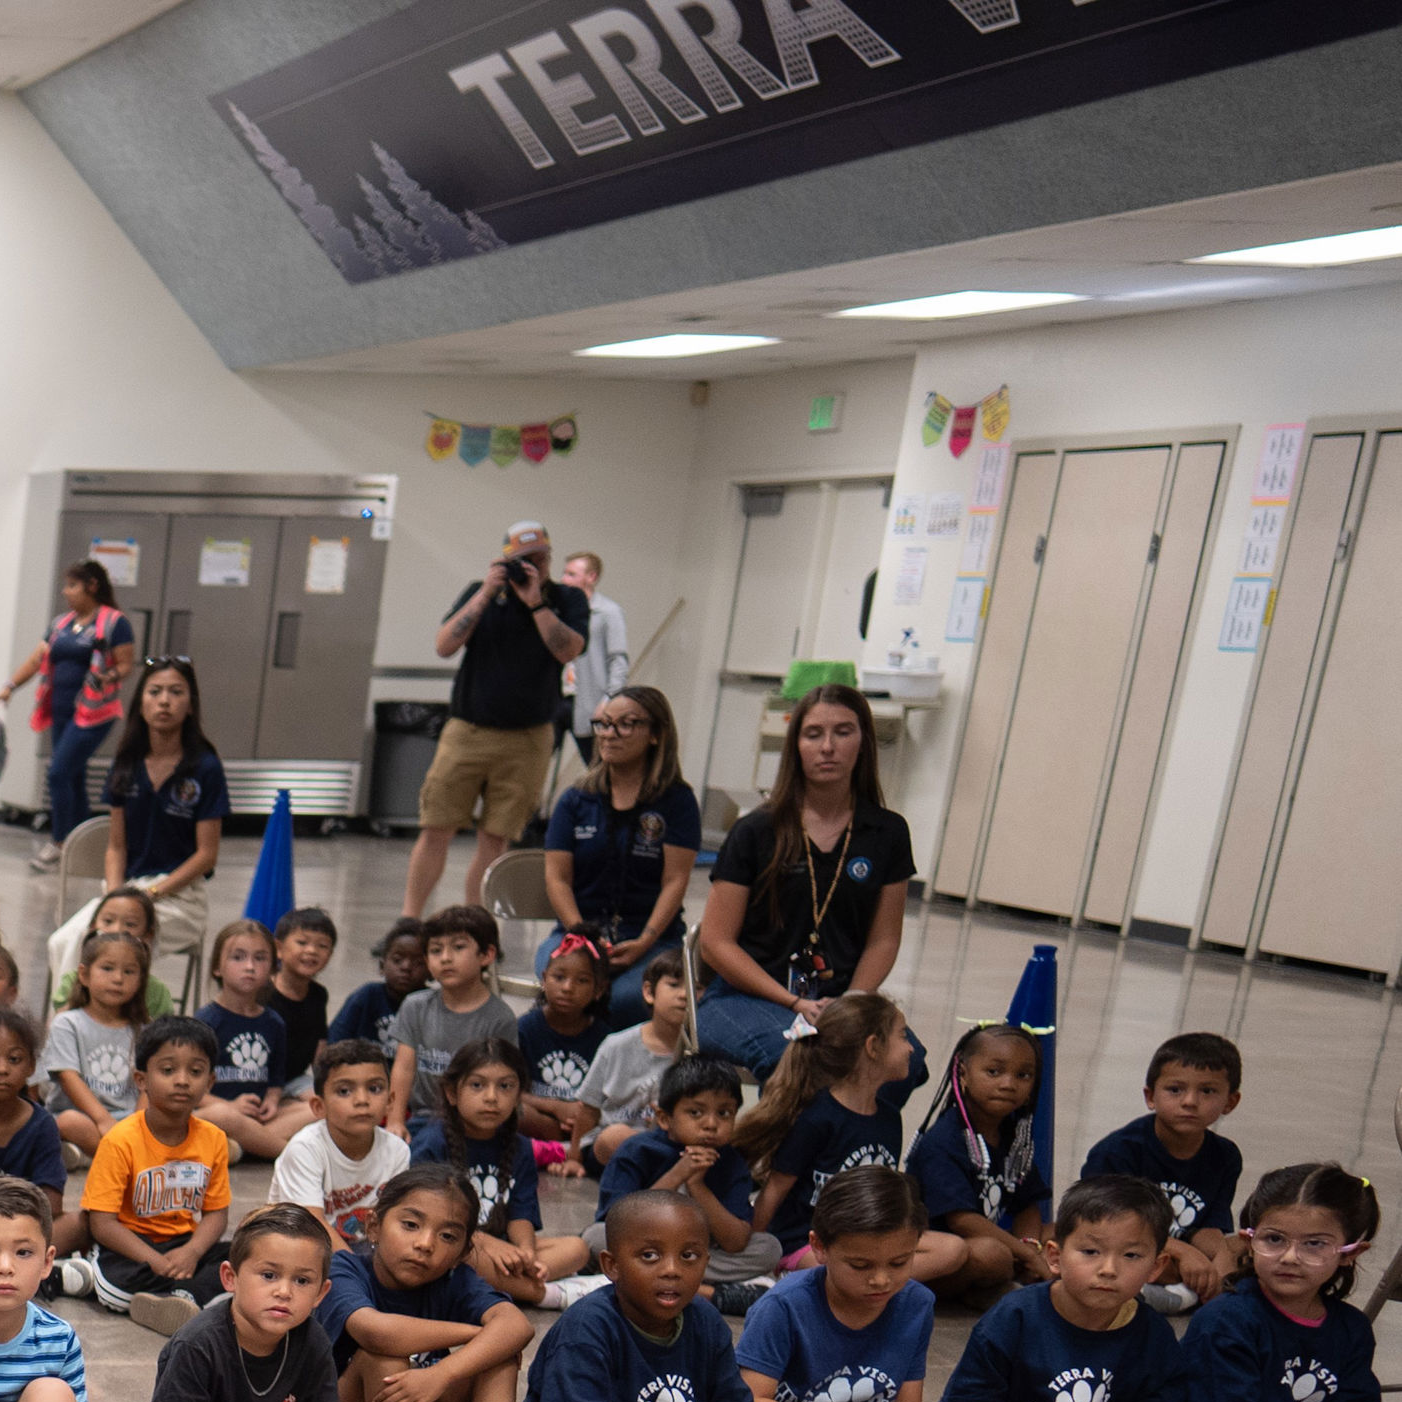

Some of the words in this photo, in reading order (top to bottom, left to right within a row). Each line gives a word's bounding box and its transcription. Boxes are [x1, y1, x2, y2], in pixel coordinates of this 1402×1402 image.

[448, 0, 902, 170] TERRA
[858, 1366, 898, 1398] VISTA
[1048, 1367, 1096, 1392] TERRA
